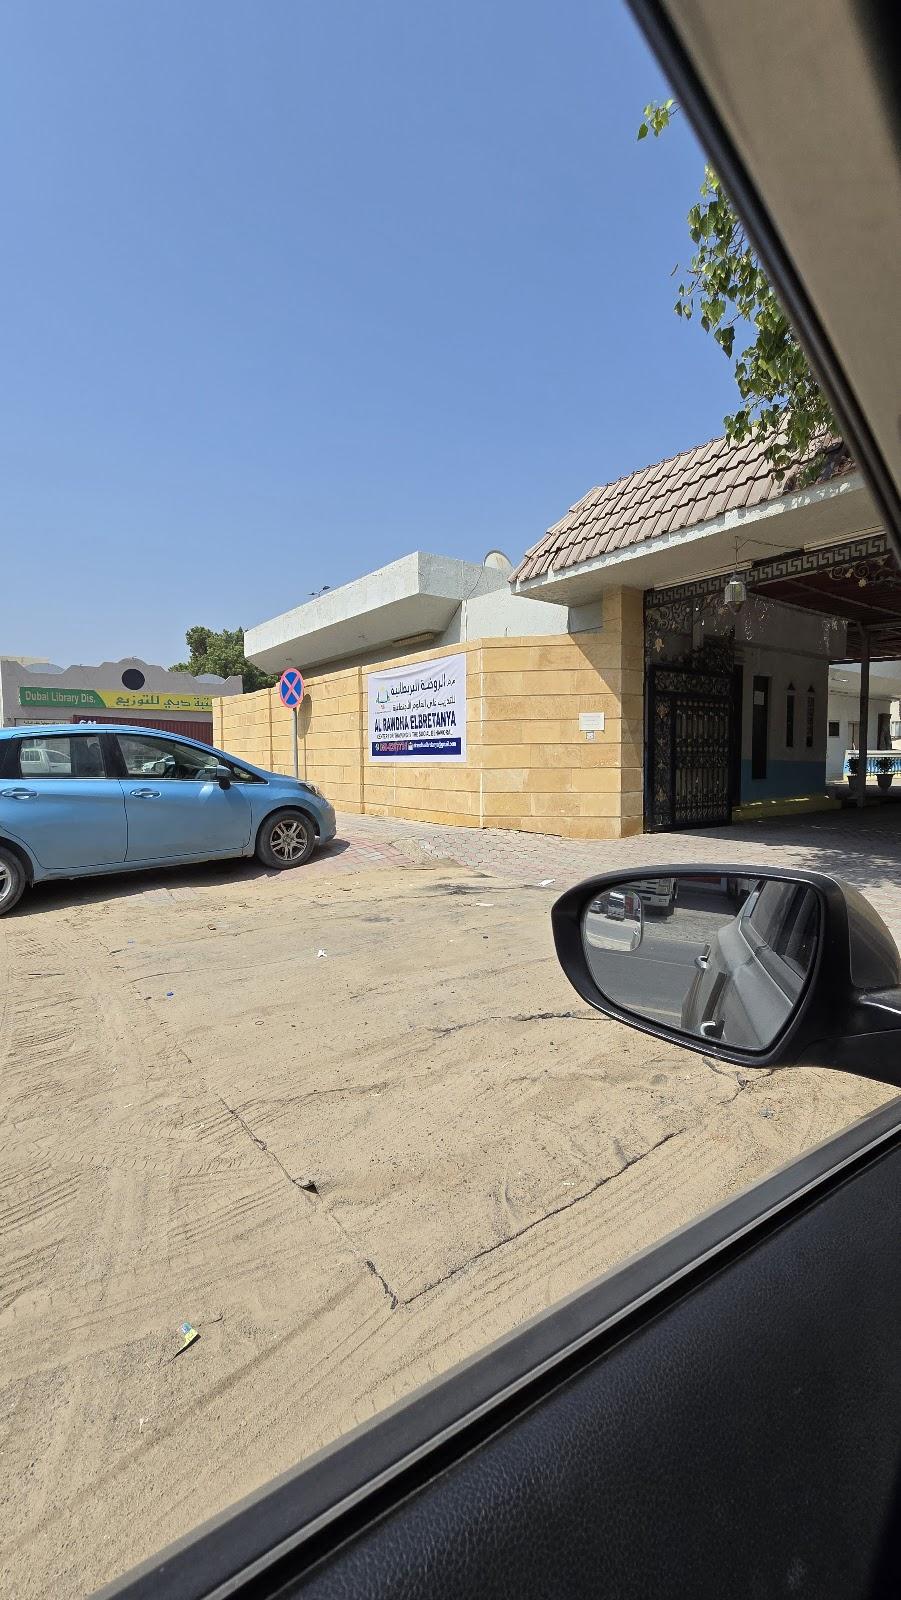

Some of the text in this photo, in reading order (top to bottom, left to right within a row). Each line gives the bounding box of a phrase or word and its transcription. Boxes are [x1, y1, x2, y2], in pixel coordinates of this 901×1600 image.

[420, 673, 446, 692] الروضة
[25, 691, 49, 701] Dubai
[51, 692, 80, 704] Library
[116, 694, 160, 707] للتوزيع
[164, 698, 191, 709] دبي
[374, 710, 457, 732] AL RAWDHA ELBRETANYA
